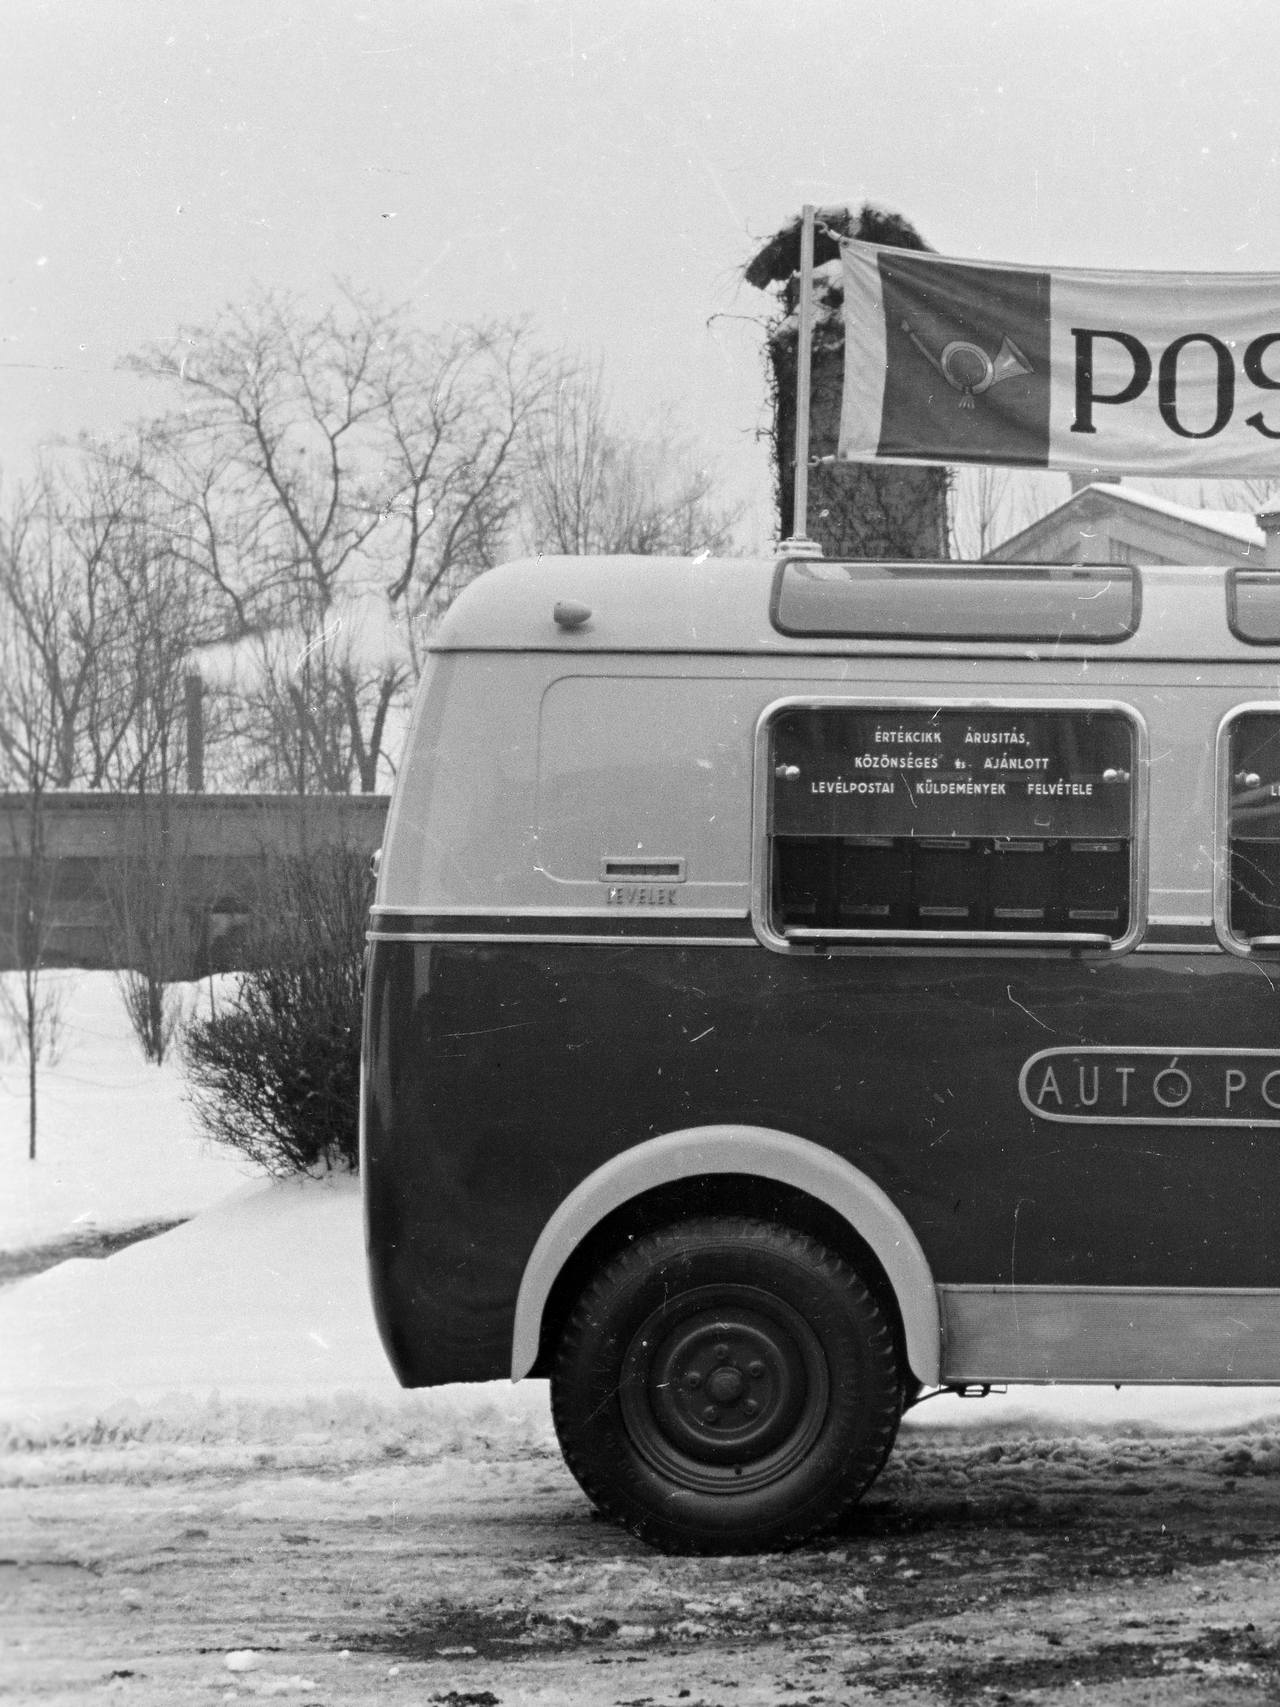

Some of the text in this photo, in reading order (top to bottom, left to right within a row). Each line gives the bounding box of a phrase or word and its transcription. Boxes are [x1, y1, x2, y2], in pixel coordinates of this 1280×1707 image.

[875, 725, 942, 743] ÉRTÉKCIKK
[811, 776, 1093, 795] LEVÉLPOSTAI KÜLDEMÉNYEK FELVÉTELE
[1037, 1057, 1192, 1108] AUTÓ
